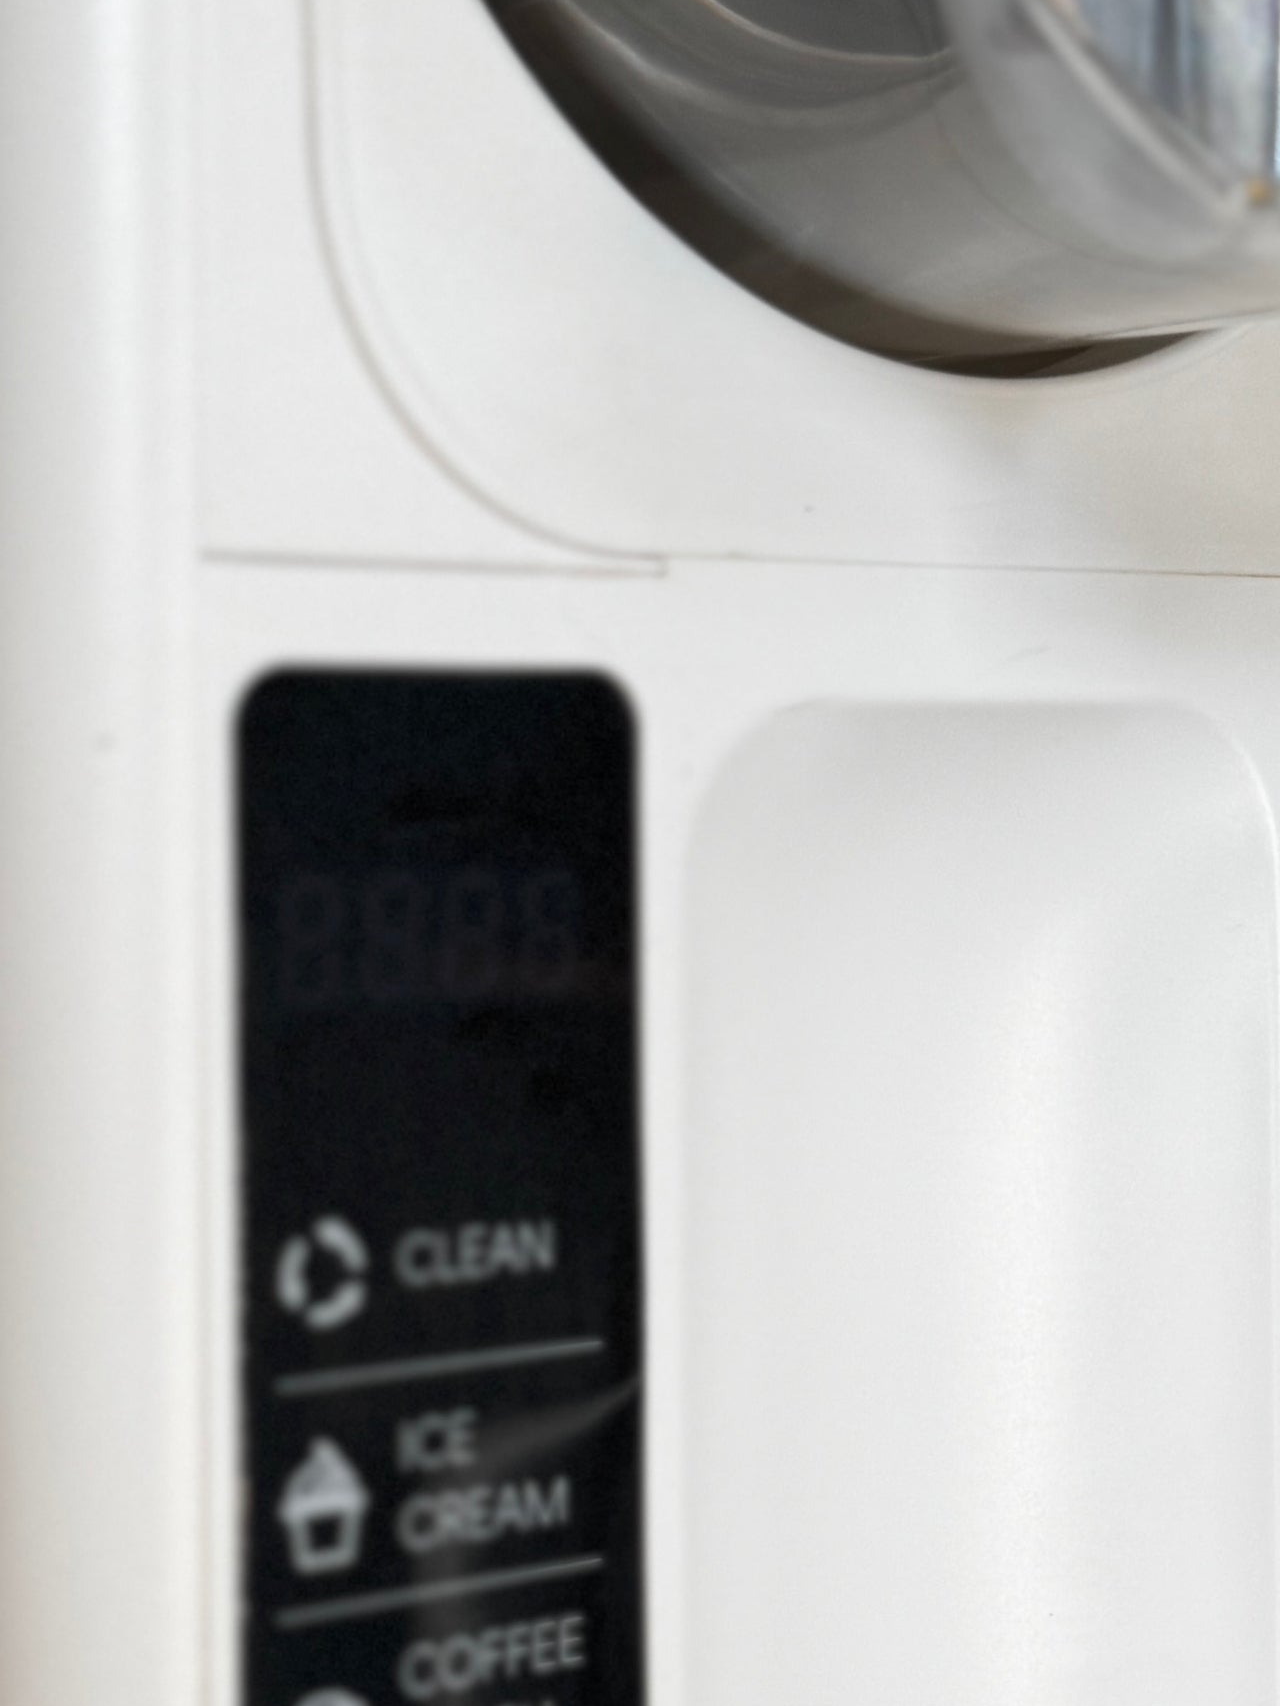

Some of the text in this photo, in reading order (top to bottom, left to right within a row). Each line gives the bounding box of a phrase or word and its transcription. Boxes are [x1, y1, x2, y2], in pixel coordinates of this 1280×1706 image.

[393, 1220, 556, 1288] CLEAN
[397, 1406, 477, 1473] ICE
[395, 1476, 570, 1554] CREAM
[398, 1612, 586, 1700] COFFEE
